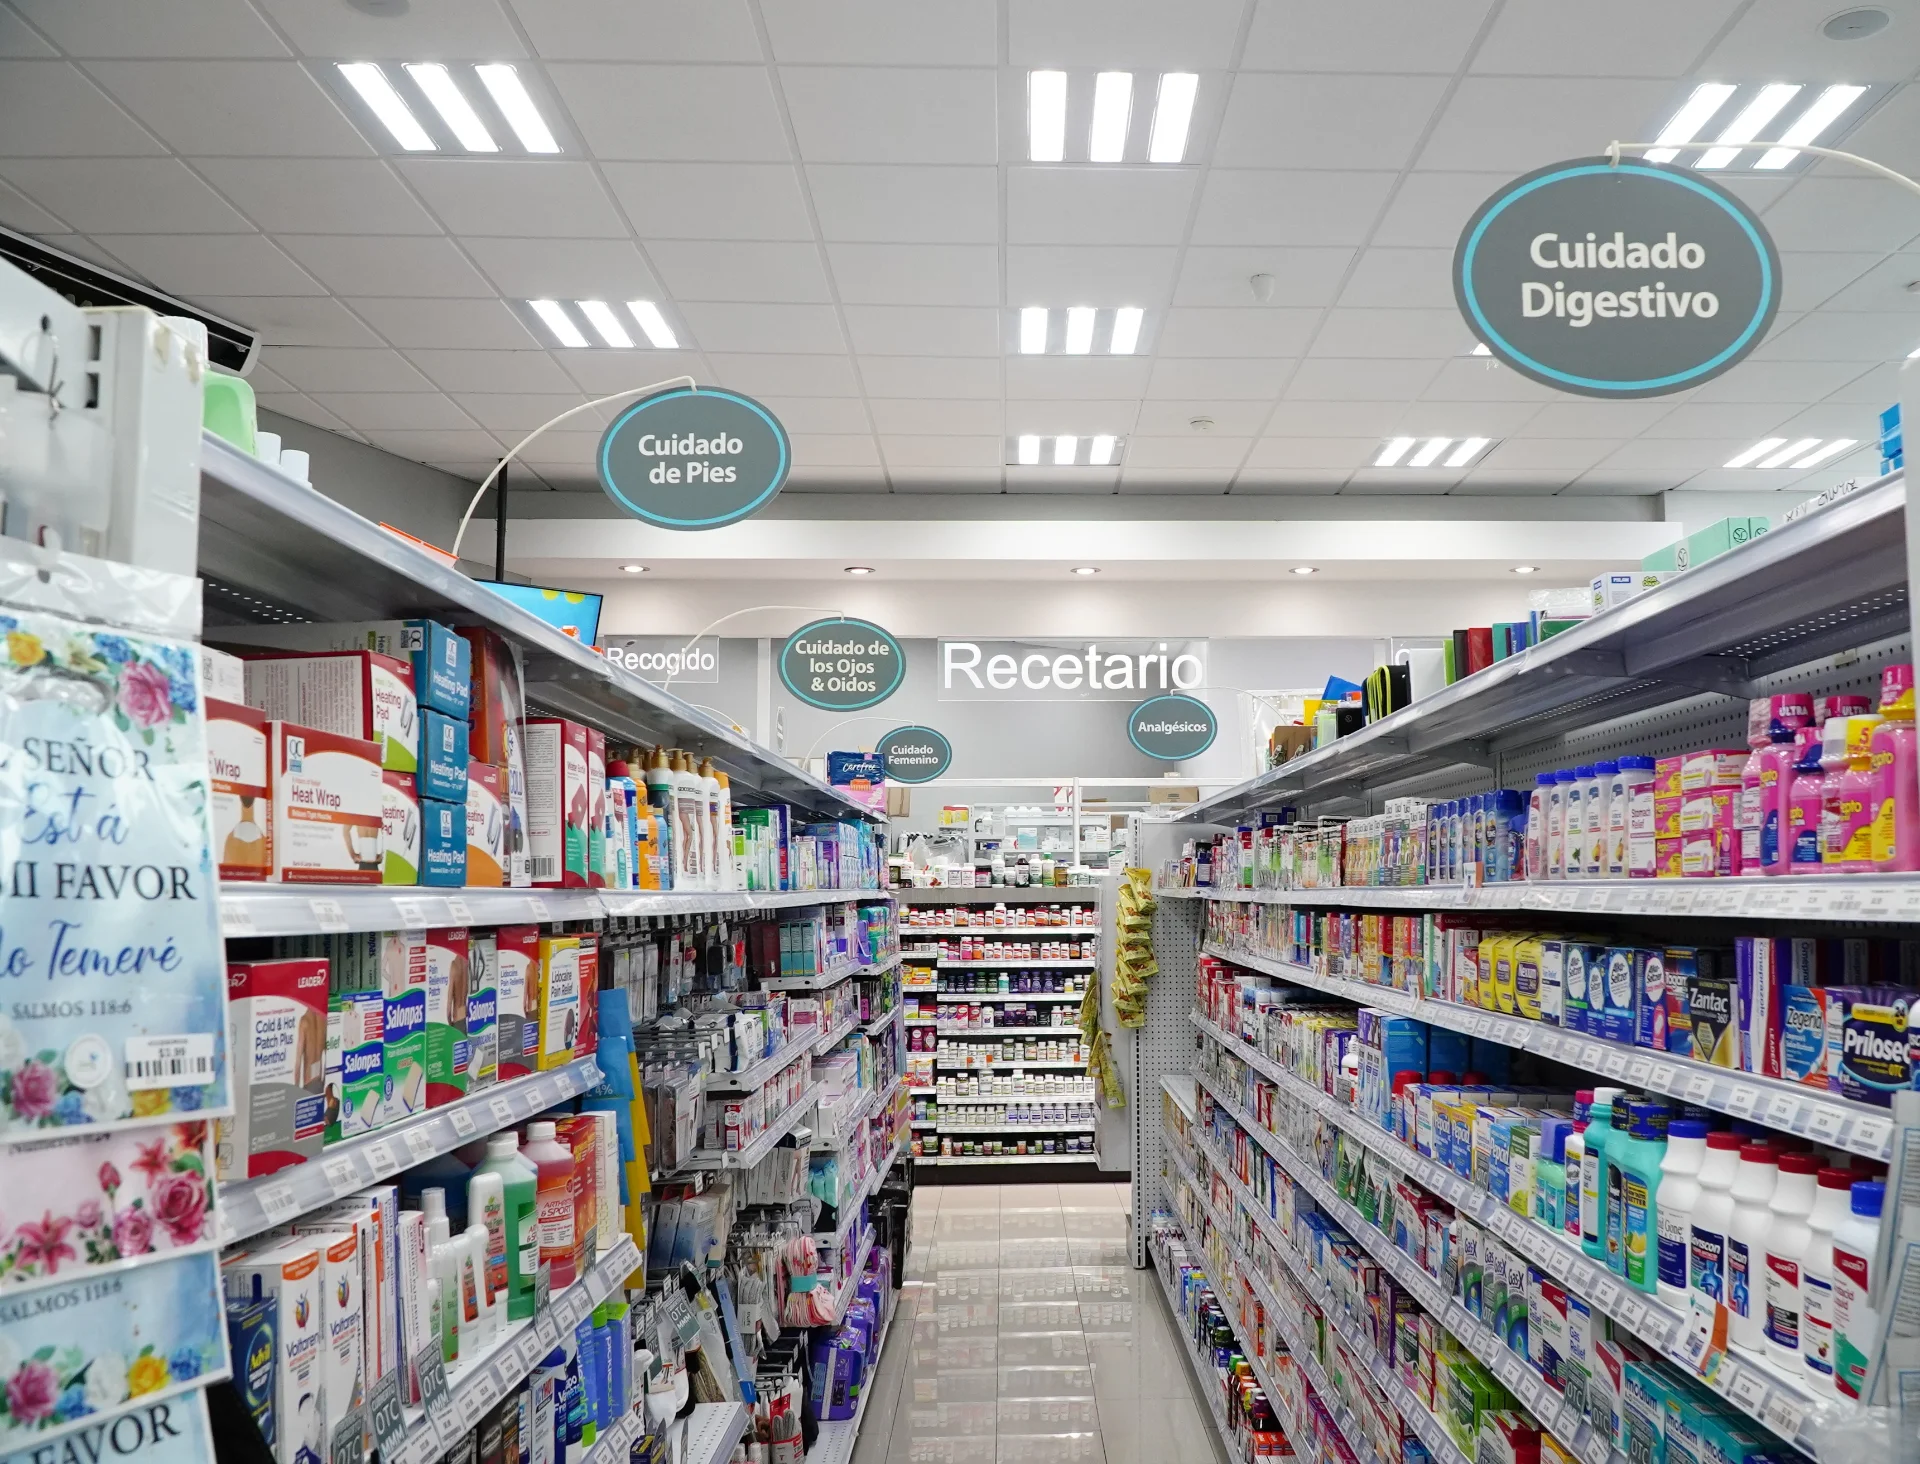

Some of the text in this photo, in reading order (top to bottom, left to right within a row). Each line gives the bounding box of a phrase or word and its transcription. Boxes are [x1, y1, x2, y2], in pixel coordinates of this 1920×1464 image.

[1530, 232, 1705, 269] Cuidado
[1521, 281, 1719, 327] Digestivo
[638, 432, 743, 456] Cuidado
[649, 461, 737, 484] de Pies
[795, 639, 889, 656] Cuidado de
[607, 647, 715, 675] Recogido
[809, 658, 875, 676] los Ojos
[944, 642, 1203, 690] Recetario
[433, 670, 468, 698] Heating Pad
[811, 677, 876, 692] & Oidos
[375, 688, 402, 709] Heating
[376, 705, 389, 720] Pad
[1779, 705, 1809, 716] ULTRA
[1137, 721, 1207, 735] Analgésicos
[23, 736, 154, 781] SEÑOR
[888, 755, 939, 765] Femenino
[891, 745, 933, 755] Cuidado
[214, 757, 241, 778] Wrap
[430, 760, 466, 781] Heating Pad
[842, 762, 876, 773] Carefree
[291, 785, 341, 809] Heat Wrap
[467, 811, 484, 824] eating
[467, 825, 475, 836] ad
[428, 849, 465, 865] Heating Pad
[55, 862, 197, 901] FAVOR
[448, 931, 466, 941] LEADER
[48, 918, 183, 980] Temeré
[429, 965, 438, 976] Pain
[551, 969, 572, 985] Lidocaine
[298, 975, 321, 988] LEADER
[550, 982, 574, 998] Pain Relief
[429, 987, 440, 998] Patch
[1690, 987, 1728, 1012] Zantac
[12, 1000, 84, 1020] SALMOS
[385, 1004, 424, 1031] Salonpas
[468, 1000, 495, 1023] Salonpas
[1786, 1007, 1822, 1030] Zegerid
[255, 1016, 296, 1034] Cold & Hot
[255, 1033, 294, 1051] Patch Plus
[326, 1037, 340, 1050] elief
[1769, 1028, 1777, 1066] LEADER
[1843, 1028, 1911, 1065] Prilosec
[255, 1048, 287, 1067] Menthol
[344, 1052, 381, 1073] Salonpas
[596, 1084, 613, 1096] 4%
[1452, 1120, 1470, 1145] Pepcid
[1490, 1138, 1509, 1167] Pepcid
[546, 1204, 572, 1216] SPORT
[1508, 1269, 1525, 1292] Gas-X
[537, 1283, 548, 1304] OTC
[671, 1302, 687, 1321] OTC
[677, 1314, 692, 1329] MMM
[1483, 1307, 1495, 1321] OTC
[329, 1312, 360, 1337] Voltaren
[1569, 1325, 1580, 1341] Gas
[286, 1332, 319, 1358] Voltaren
[251, 1343, 271, 1370] Advil
[423, 1363, 443, 1397] OTC
[428, 1388, 449, 1416] MMM
[1567, 1382, 1582, 1407] OTC
[375, 1396, 400, 1434] OTC
[1593, 1406, 1609, 1433] OTC
[337, 1435, 362, 1464] OTC
[381, 1430, 405, 1460] MMM
[1631, 1438, 1648, 1461] OTC
